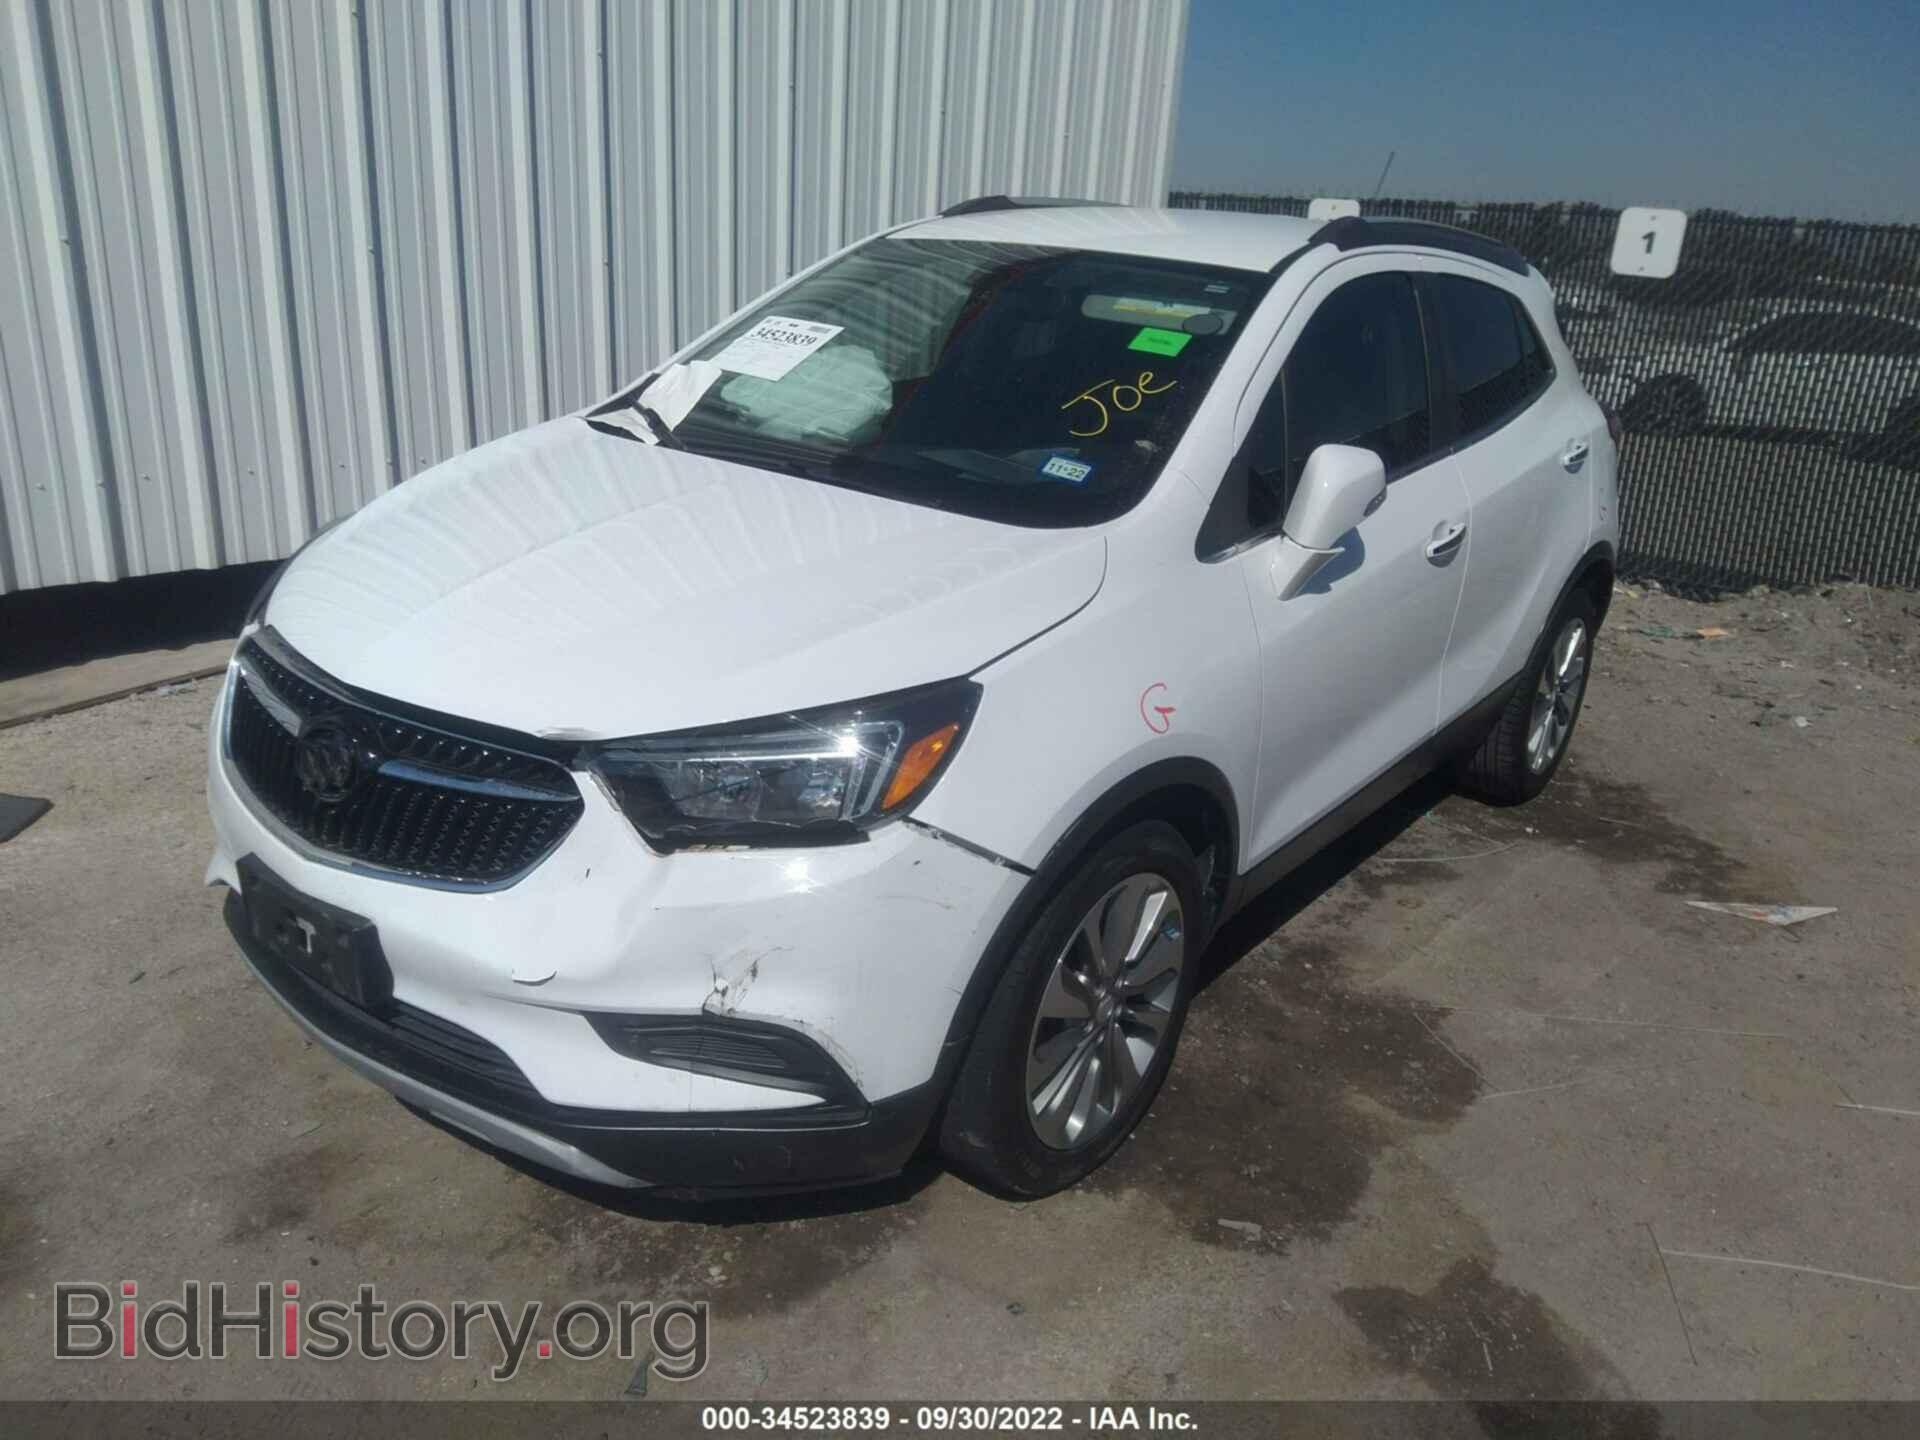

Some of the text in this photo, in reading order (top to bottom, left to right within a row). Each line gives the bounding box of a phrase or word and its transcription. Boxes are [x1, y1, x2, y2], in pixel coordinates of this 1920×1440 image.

[1641, 231, 1656, 255] 1
[752, 327, 818, 346] 34523839
[1140, 682, 1177, 734] G
